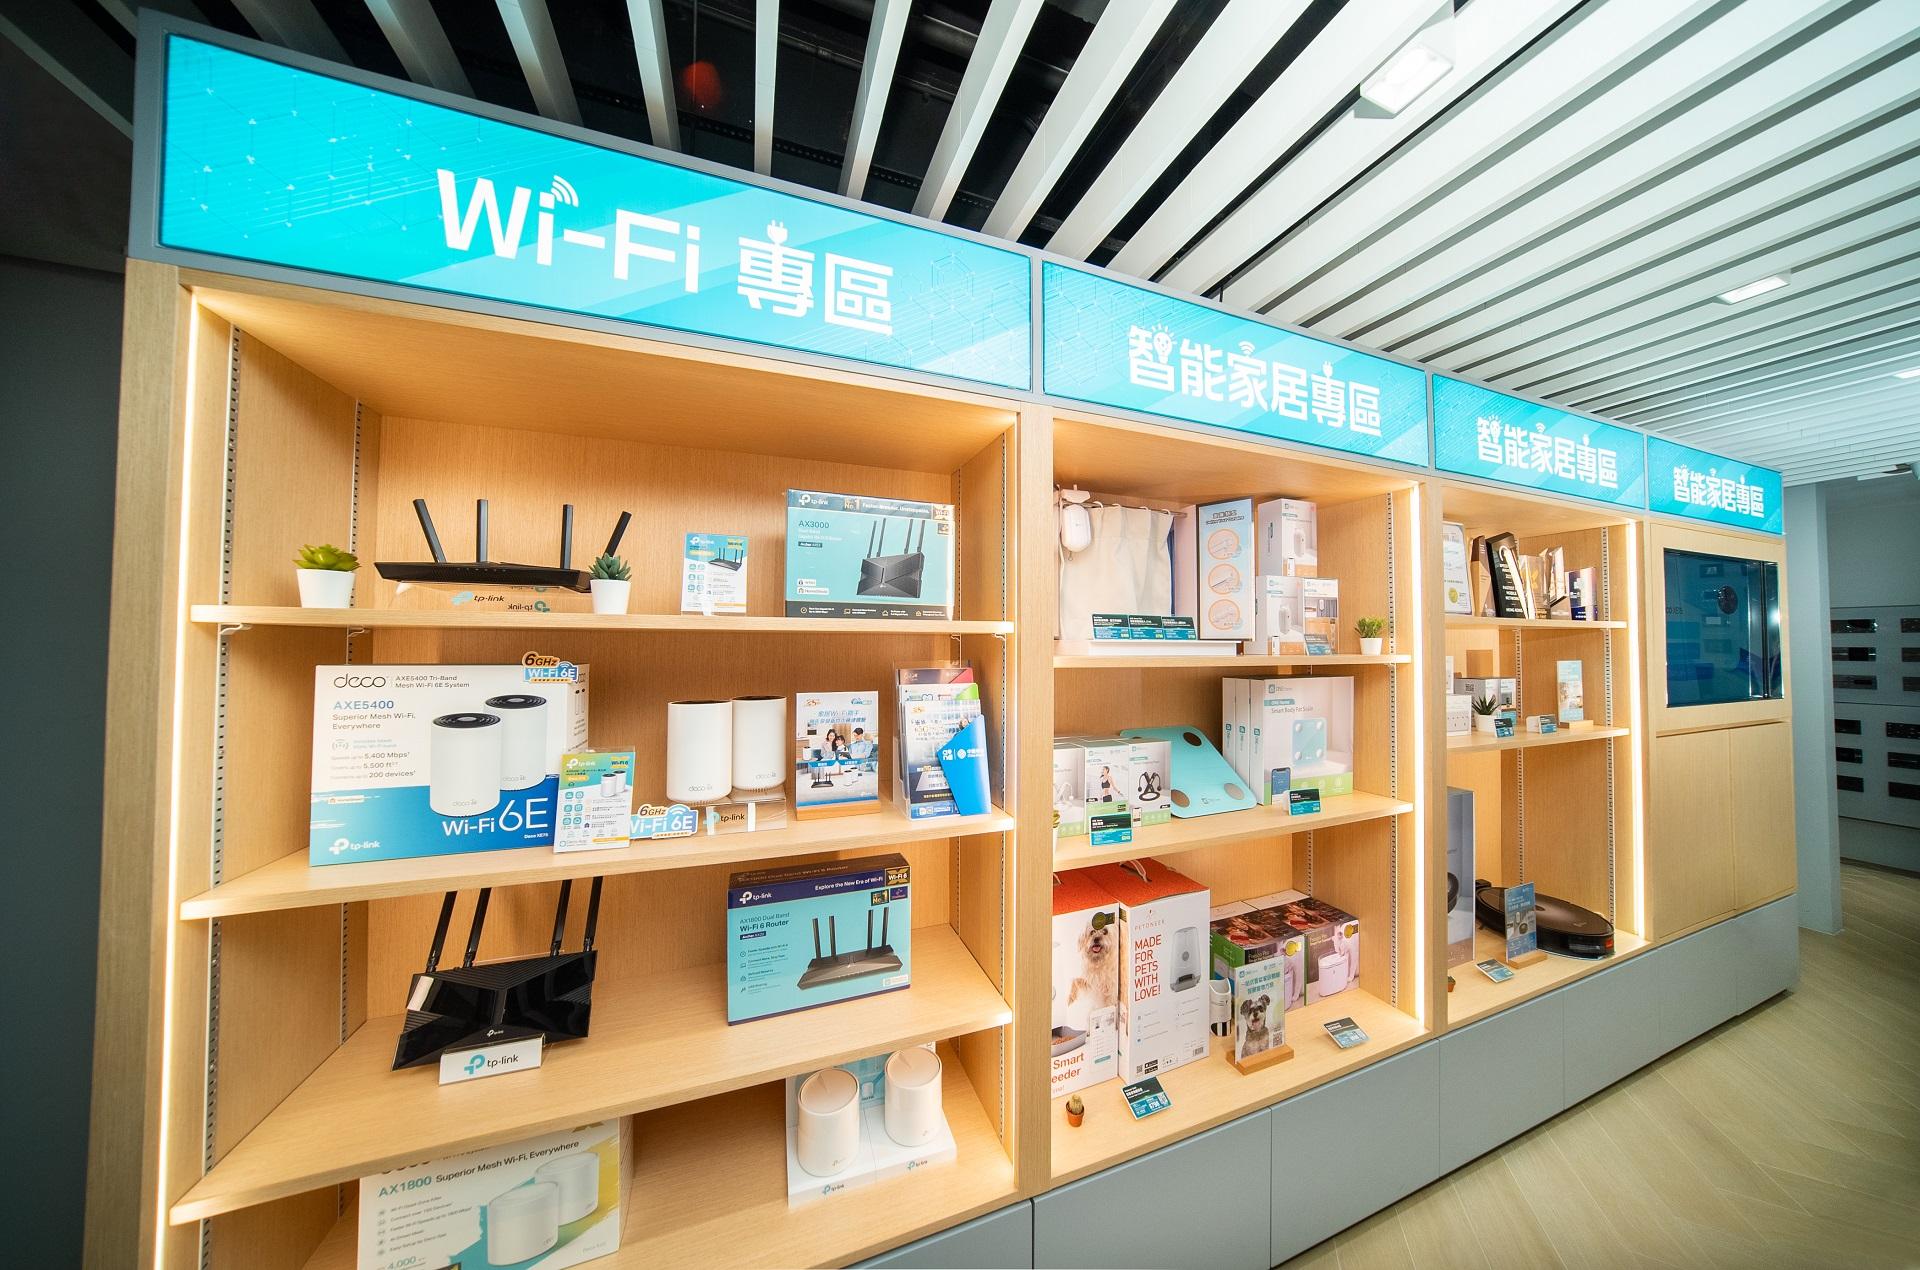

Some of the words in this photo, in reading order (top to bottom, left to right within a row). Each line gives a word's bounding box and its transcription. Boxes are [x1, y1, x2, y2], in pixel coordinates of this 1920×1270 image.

[437, 169, 700, 293] Wi-Fi
[737, 228, 893, 335] 專區
[1128, 325, 1381, 435] 智能家居專區
[1477, 416, 1617, 489] 智能家居專區
[1673, 466, 1764, 518] 智能家居專區
[799, 520, 829, 529] AX3000
[525, 653, 557, 666] 6GHz
[528, 668, 558, 678] Wi-Fi
[560, 667, 576, 678] 6E
[334, 673, 386, 688] deco
[334, 700, 394, 710] AXE5400
[332, 712, 368, 721] Superior
[370, 712, 392, 720] Mesh
[332, 722, 380, 730] Everywhere
[442, 817, 494, 836] Wi-Fi
[498, 798, 548, 832] 6E
[640, 806, 666, 816] 6GHz
[720, 813, 745, 822] tp-link
[671, 816, 694, 831] 6E
[350, 841, 380, 850] tp-link
[752, 892, 772, 900] tp-link
[815, 883, 834, 891] Explore
[740, 916, 762, 924] AX1800
[740, 922, 758, 932] Wi-Fi
[766, 920, 789, 928] Router
[1135, 934, 1162, 952] MADE
[1135, 950, 1153, 964] FOR
[1135, 960, 1158, 976] PETS
[1134, 972, 1158, 989] WITH
[1134, 984, 1160, 1002] LOVE!
[487, 1054, 518, 1068] tp-link
[1053, 1052, 1084, 1070] Smart
[378, 1176, 432, 1197] AX1800
[436, 1166, 476, 1183] Superior
[478, 1160, 502, 1173] Mesh
[530, 1141, 580, 1159] Everywhere
